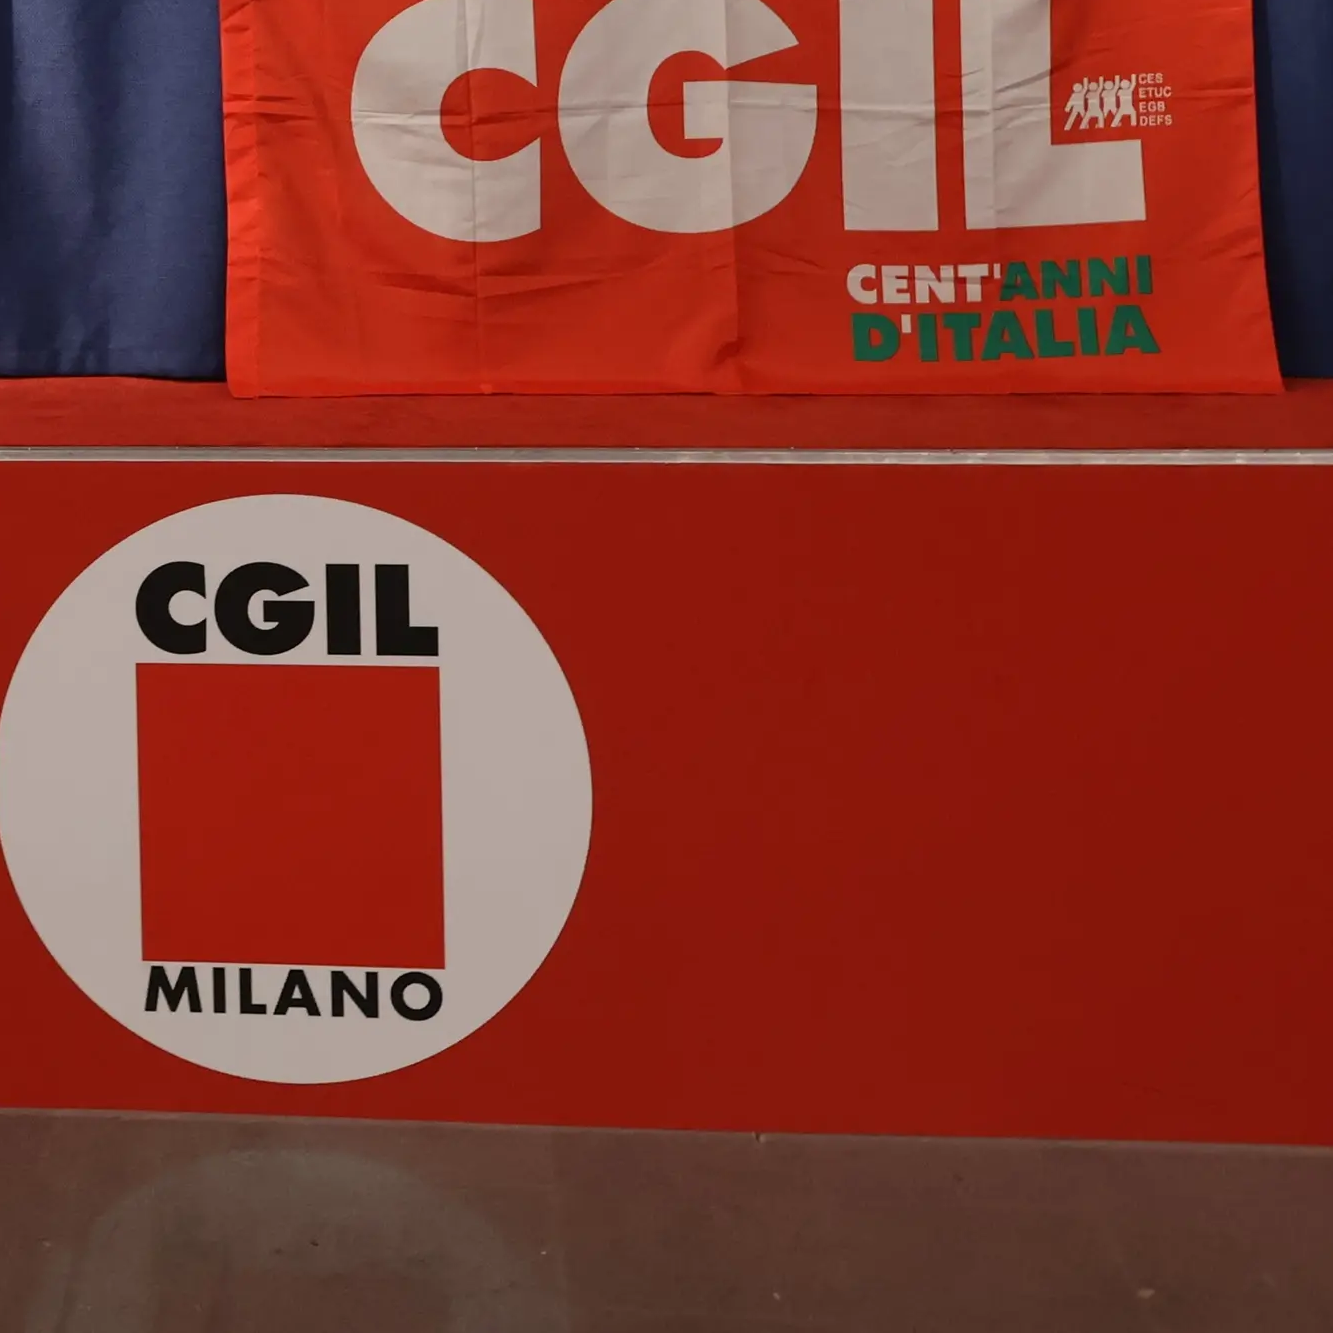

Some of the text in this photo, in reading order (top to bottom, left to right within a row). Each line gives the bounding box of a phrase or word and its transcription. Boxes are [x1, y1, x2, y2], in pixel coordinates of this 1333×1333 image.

[1138, 73, 1163, 84] CES
[1138, 86, 1172, 99] ETUC
[1139, 101, 1165, 113] EGB
[1140, 115, 1172, 126] DEFS
[846, 255, 1153, 305] CENT'ANNI
[851, 304, 1162, 362] D'ITALIA
[135, 561, 439, 657] CGIL
[144, 965, 444, 1022] MILANO
